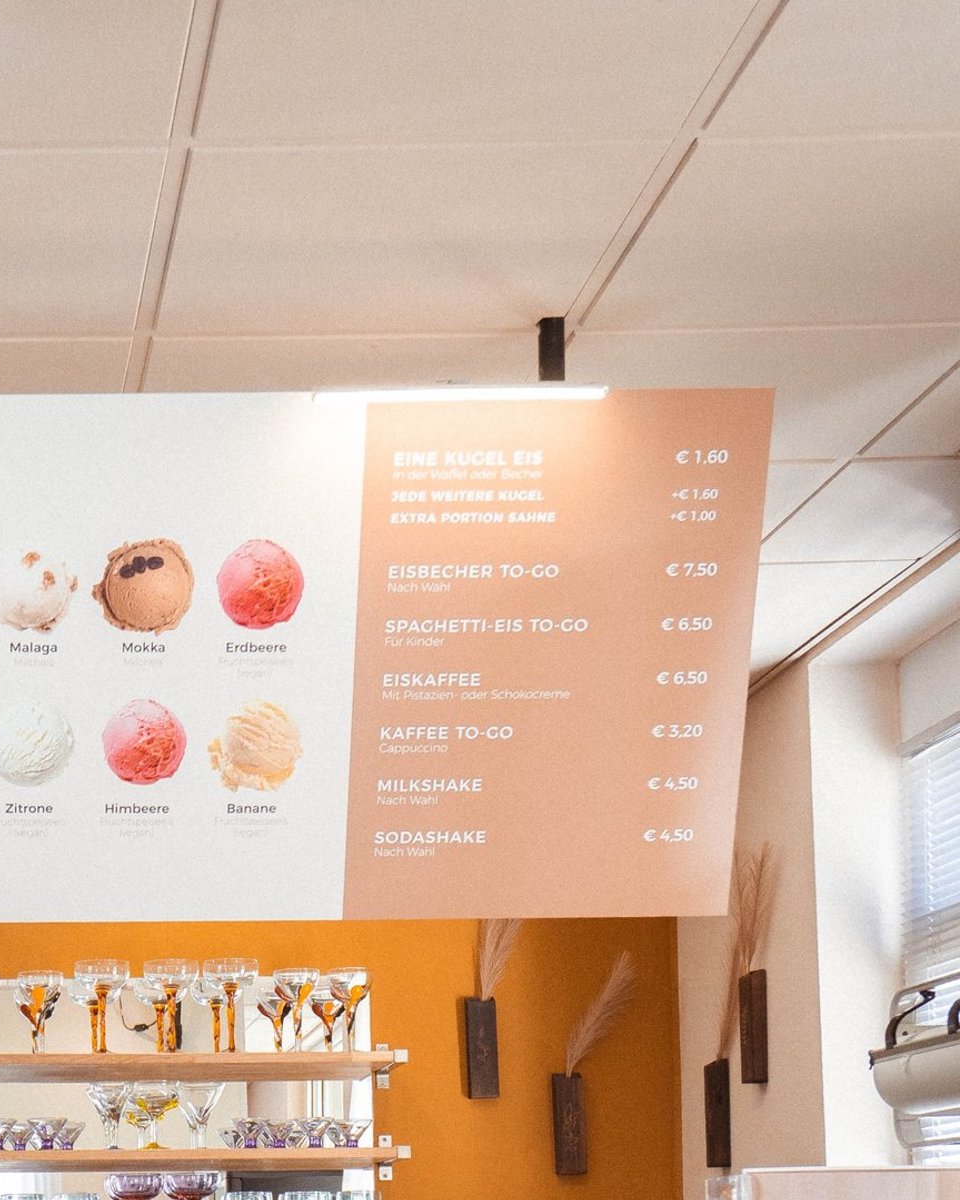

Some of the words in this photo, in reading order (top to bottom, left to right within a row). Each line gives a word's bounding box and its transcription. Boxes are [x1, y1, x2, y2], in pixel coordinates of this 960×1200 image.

[393, 450, 438, 467] EINE
[444, 450, 507, 466] KUGEL
[513, 449, 544, 465] EIS
[674, 449, 690, 465] €
[391, 490, 426, 502] JEDE
[431, 489, 494, 502] WEITERE
[498, 489, 545, 501] KUGEL
[390, 512, 437, 524] EXTRA
[440, 511, 504, 524] PORTION
[508, 511, 557, 523] SAHNE
[388, 564, 493, 579] EISBECHER
[499, 564, 560, 579] TO-GO
[665, 562, 680, 577] €
[387, 582, 418, 593] Nach
[421, 582, 451, 592] Wahl
[385, 618, 523, 634] SPAGHETTI-EIS
[529, 618, 589, 633] TO-GO
[660, 617, 675, 631] €
[121, 641, 166, 654] Mokka
[225, 641, 288, 654] Erdbeere
[384, 636, 403, 647] Für
[406, 636, 445, 647] Kinder
[9, 641, 58, 656] Malaga
[383, 672, 481, 688] EISKAFFEE
[656, 671, 670, 685] €
[382, 689, 400, 701] Mit
[461, 690, 487, 700] oder
[491, 689, 570, 700] Schokocreme
[380, 726, 449, 740] KAFFEE
[454, 726, 513, 740] TO-GO
[651, 724, 665, 738] €
[378, 742, 449, 756] Cappuccino
[377, 778, 483, 793] MILKSHAKE
[646, 777, 661, 790] €
[376, 795, 407, 806] Nach
[409, 795, 438, 805] Wahl
[5, 802, 54, 814] Zitrone
[104, 802, 170, 815] Himbeere
[226, 803, 277, 814] Banane
[374, 830, 487, 845] SODASHAKE
[643, 829, 657, 842] €
[373, 846, 404, 857] Nach
[406, 846, 435, 857] Wahl
